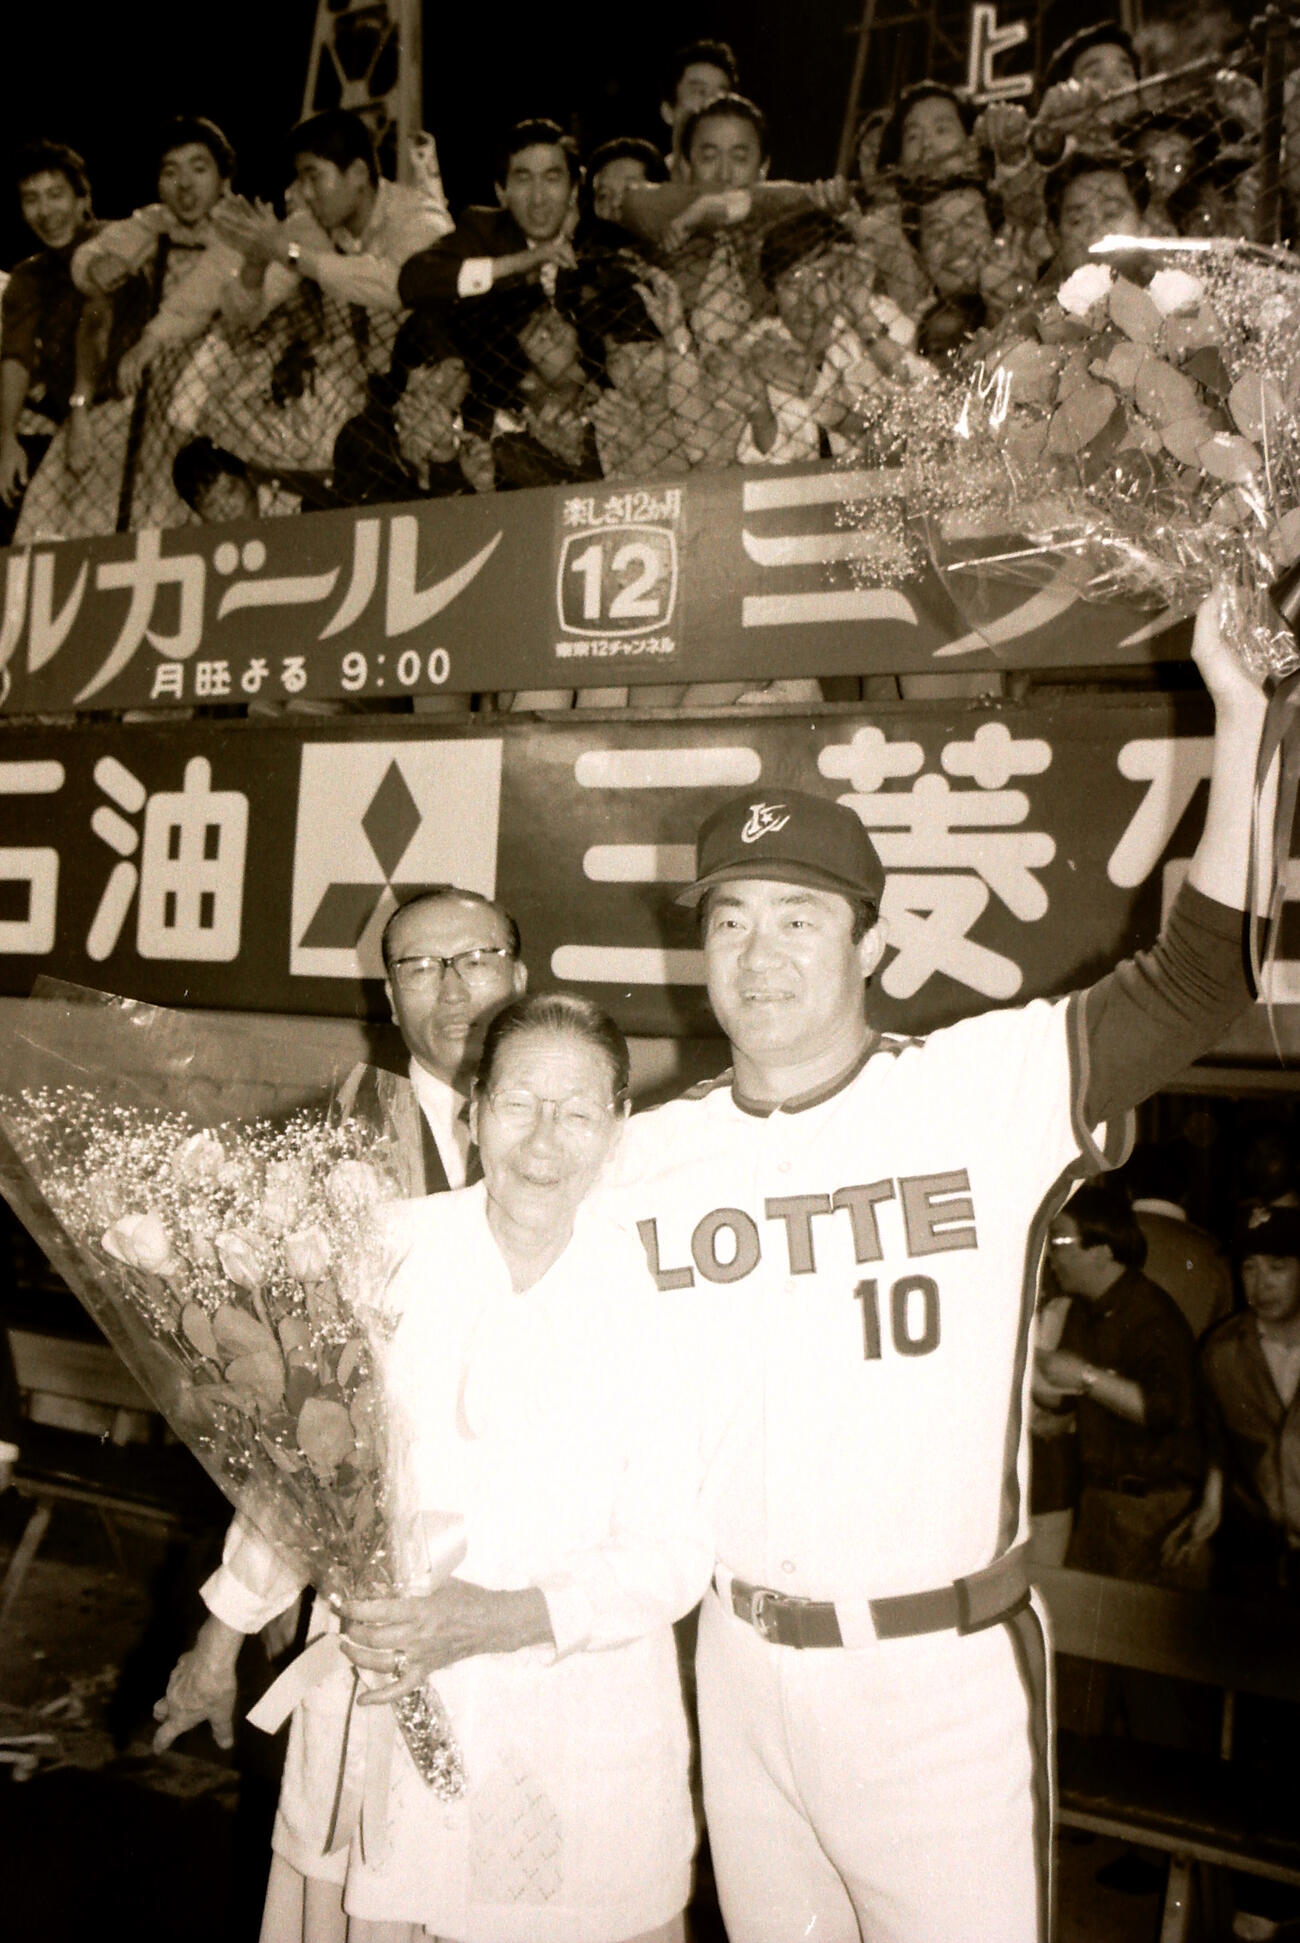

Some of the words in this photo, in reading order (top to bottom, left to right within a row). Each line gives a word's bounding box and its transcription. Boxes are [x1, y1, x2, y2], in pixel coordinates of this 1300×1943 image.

[570, 542, 661, 620] 12
[341, 647, 451, 692] 9:00
[636, 1168, 978, 1292] LOTTE
[853, 1274, 941, 1361] 10
